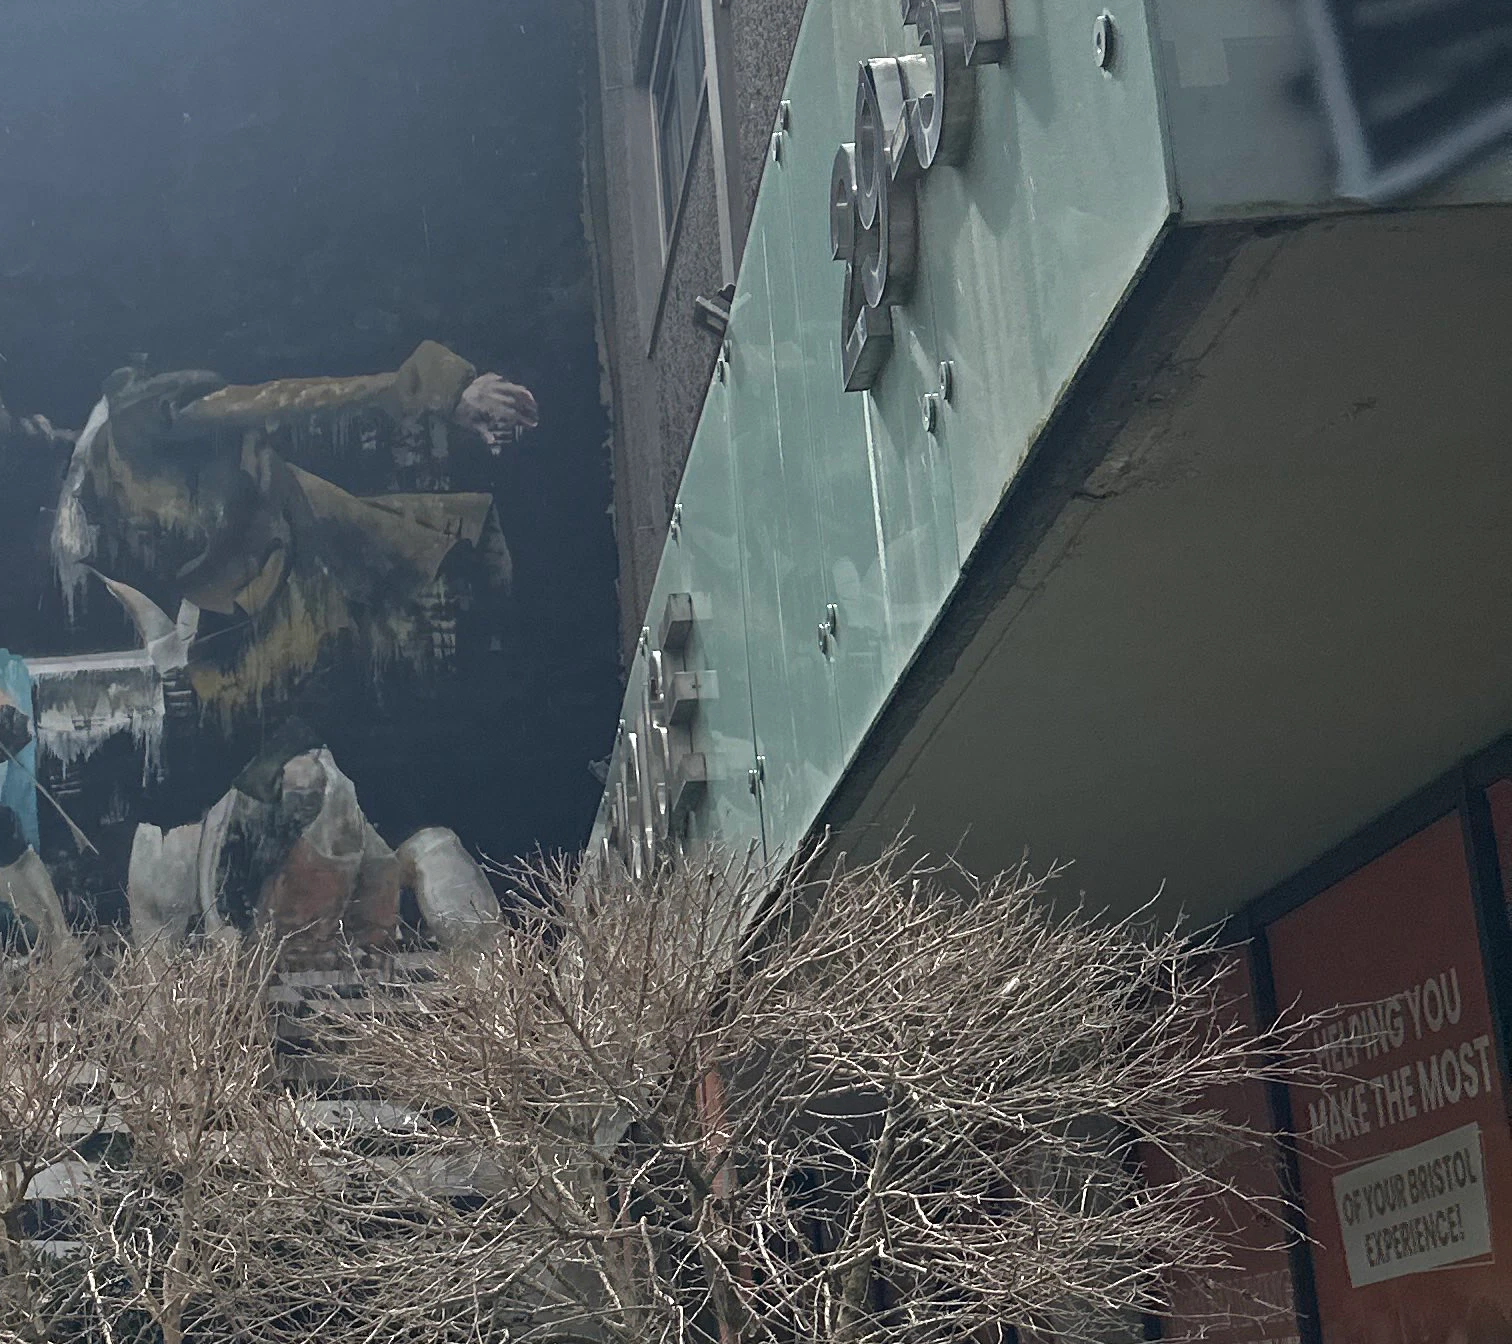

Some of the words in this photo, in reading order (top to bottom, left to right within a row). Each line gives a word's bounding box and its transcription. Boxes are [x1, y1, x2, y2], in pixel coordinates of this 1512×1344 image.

[1313, 1000, 1405, 1073] HELPING
[1406, 968, 1462, 1040] YOU
[1308, 1083, 1371, 1149] MAKE
[1371, 1066, 1418, 1128] THE
[1417, 1035, 1491, 1113] MOST
[1342, 1192, 1361, 1226] OF
[1362, 1174, 1408, 1219] YOUR
[1408, 1148, 1478, 1204] BRISTOL
[1365, 1203, 1465, 1268] EXPERIENCE!
